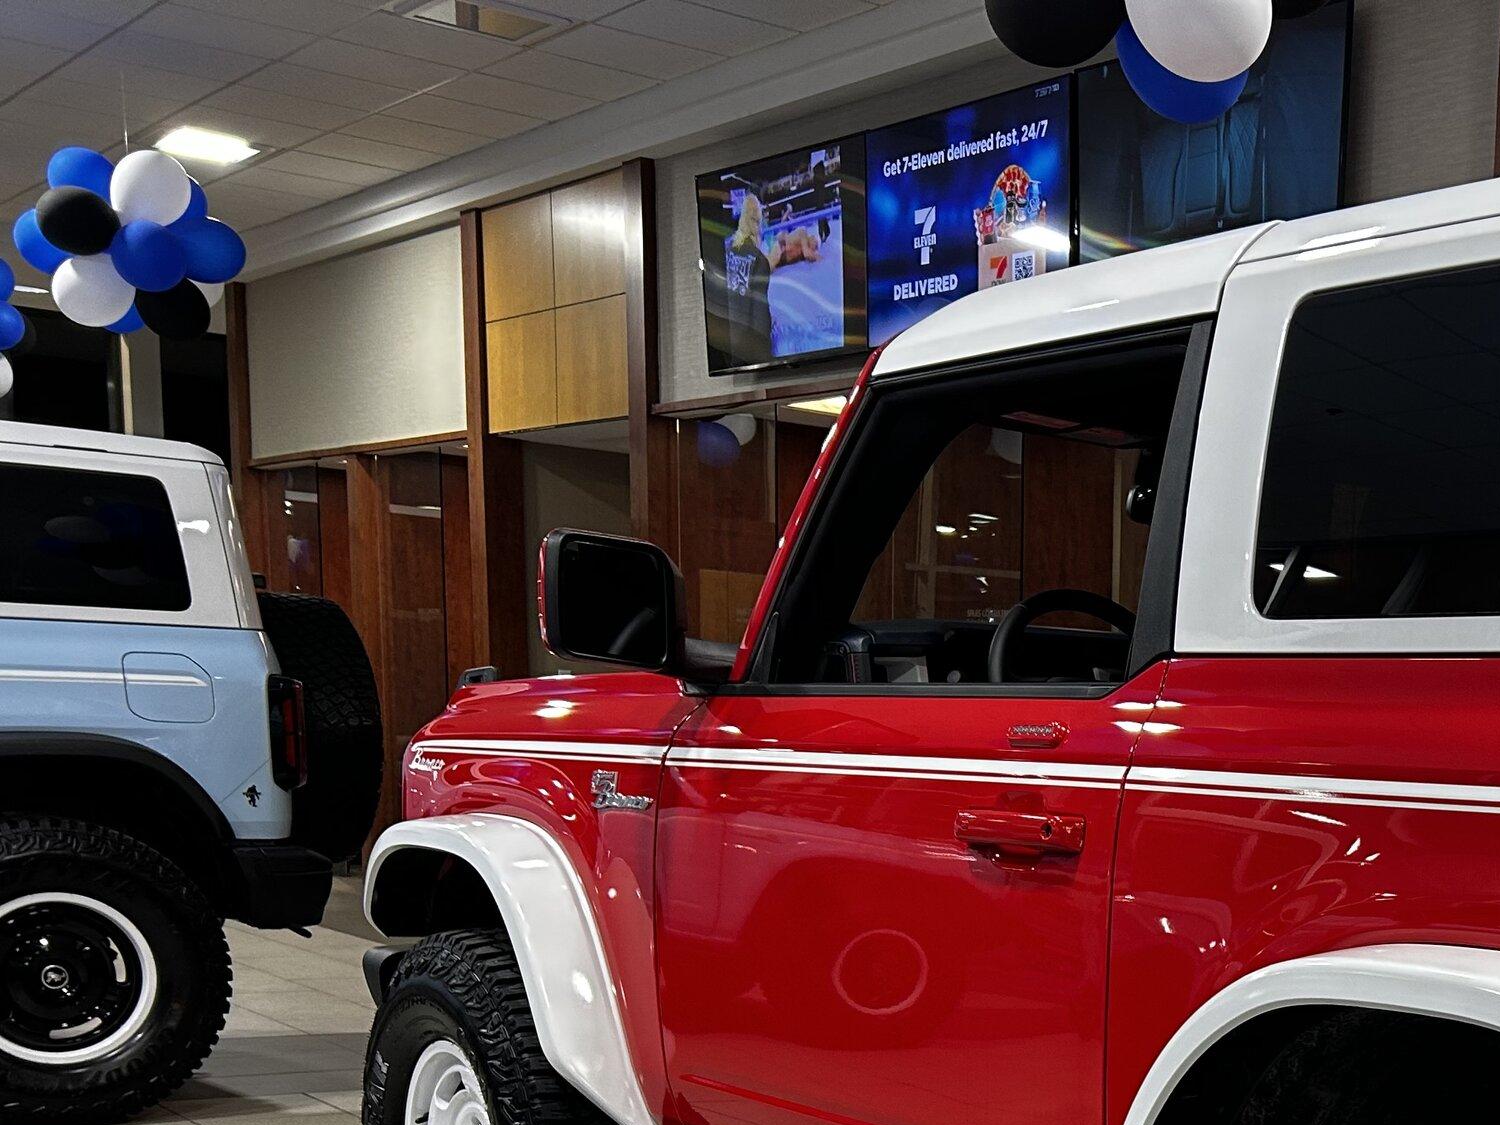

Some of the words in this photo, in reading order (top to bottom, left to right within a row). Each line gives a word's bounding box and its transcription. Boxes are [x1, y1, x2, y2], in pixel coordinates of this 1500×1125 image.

[883, 154, 901, 178] Get
[902, 149, 945, 173] 7-Eleven
[947, 133, 994, 161] delivered
[995, 128, 1019, 149] fast,
[1021, 119, 1049, 143] 24/7
[893, 273, 958, 301] DELIVERED
